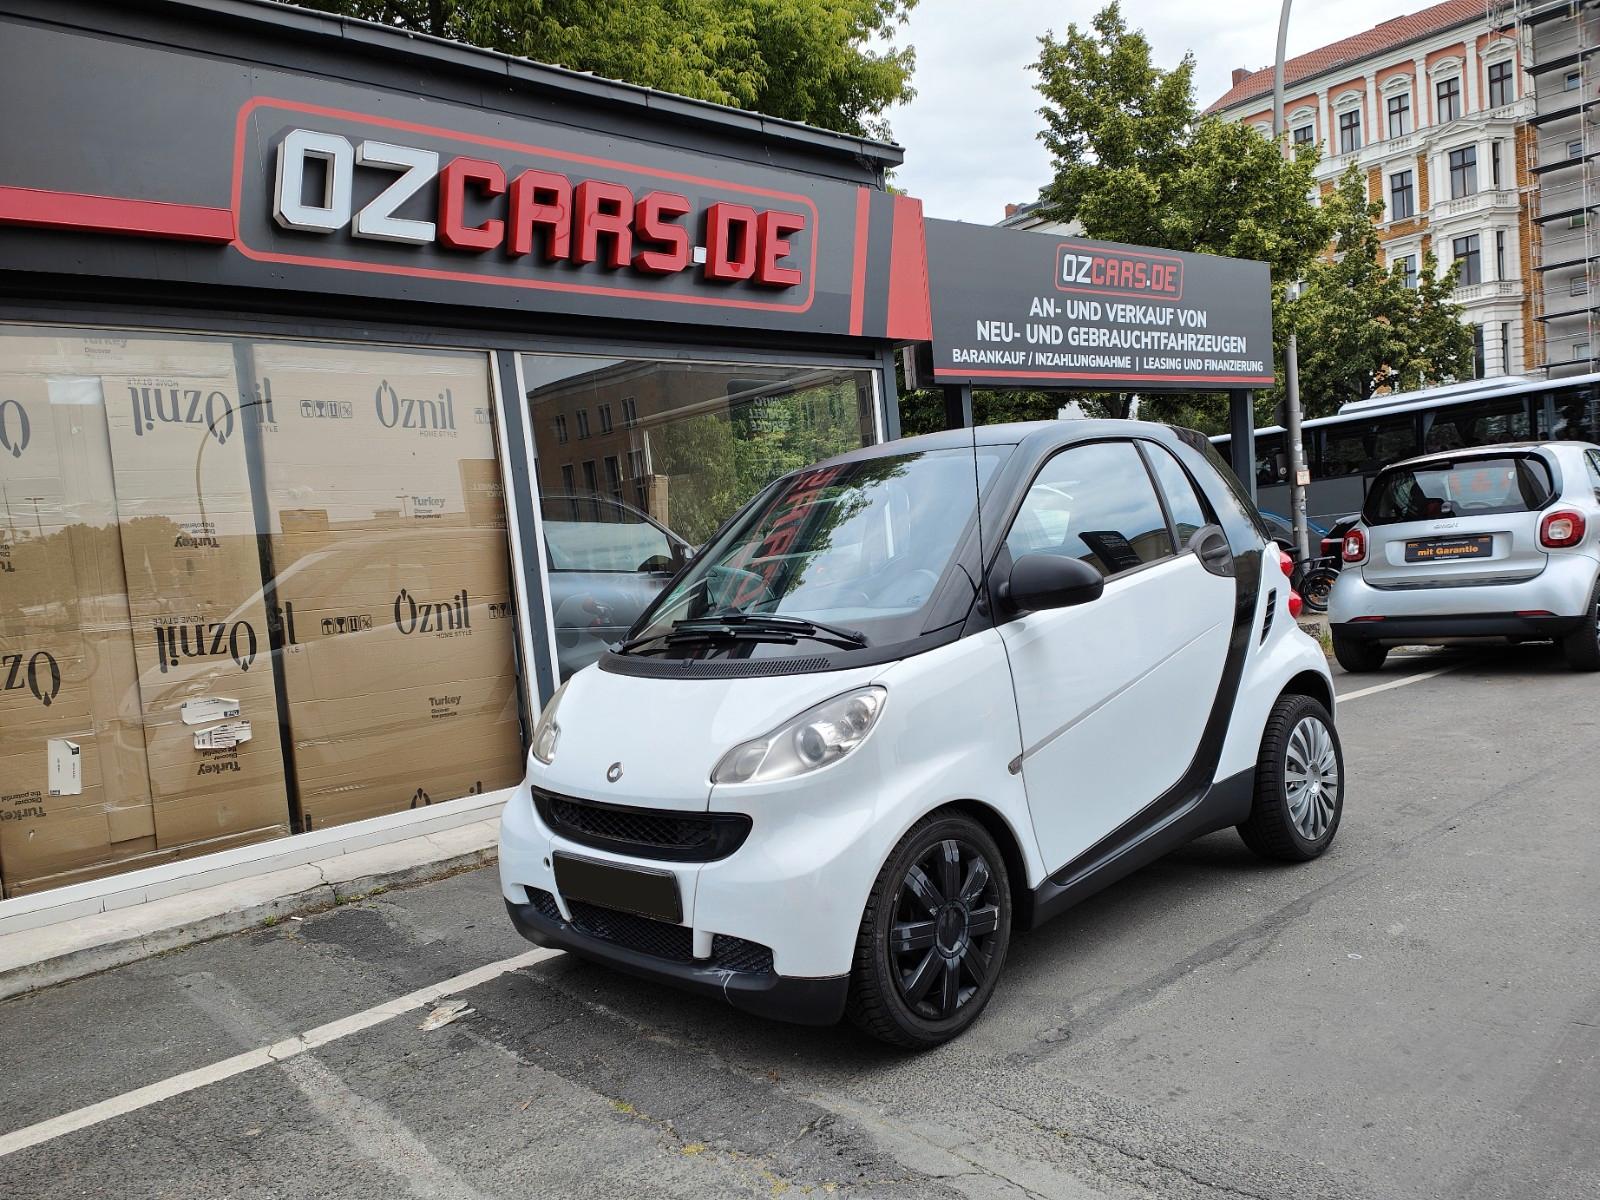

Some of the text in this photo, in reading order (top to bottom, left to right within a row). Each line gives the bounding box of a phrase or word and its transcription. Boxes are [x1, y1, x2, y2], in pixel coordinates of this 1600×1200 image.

[272, 127, 805, 289] OZCARS.DE
[1062, 254, 1177, 292] OZCARS.DE
[1029, 296, 1207, 328] AN- UND VERKAUF VON
[976, 319, 1247, 354] NEU- UND GEBRAUCHTFAHRZEUGEN
[952, 348, 1026, 366] BARANKAUF
[1035, 352, 1131, 370] INZAHLUNGNAHME
[1143, 356, 1182, 371] LEASING
[1183, 358, 1203, 371] UND
[1204, 359, 1264, 372] FINANZIERUNG
[411, 496, 446, 508] Turkey
[174, 536, 220, 549] Turkey
[428, 695, 462, 706] Turkey
[197, 761, 240, 775] Turkey
[14, 797, 42, 806] Discover
